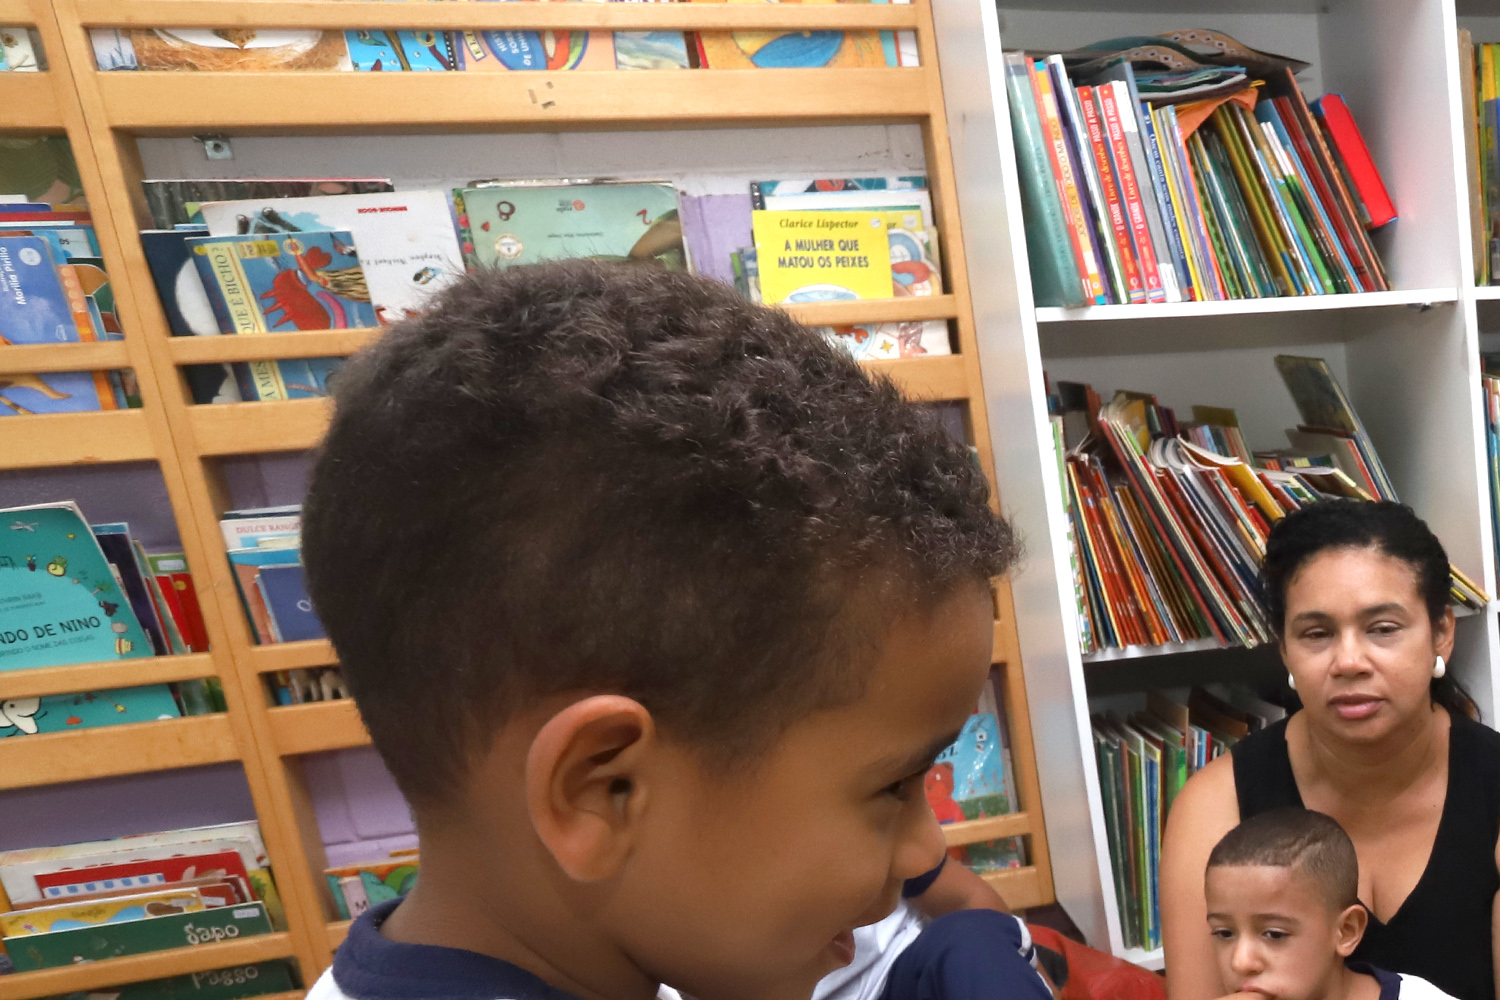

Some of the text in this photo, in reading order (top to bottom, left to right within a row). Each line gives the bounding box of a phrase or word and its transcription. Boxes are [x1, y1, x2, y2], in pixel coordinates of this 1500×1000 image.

[1083, 99, 1095, 117] PASSO
[1103, 98, 1115, 115] PASSO
[1089, 124, 1101, 141] PASSO
[1110, 122, 1121, 140] PASSO
[1109, 203, 1123, 224] GRANDE
[1129, 201, 1142, 223] GRANDE
[779, 218, 858, 230] Clarice Lispector
[1075, 207, 1086, 238] JOGOS
[785, 240, 859, 252] A MULHER QUE
[778, 256, 869, 268] MATOU OS PEIXES
[33, 624, 56, 639] DE
[60, 616, 101, 633] NINO
[184, 923, 239, 945] Sapo
